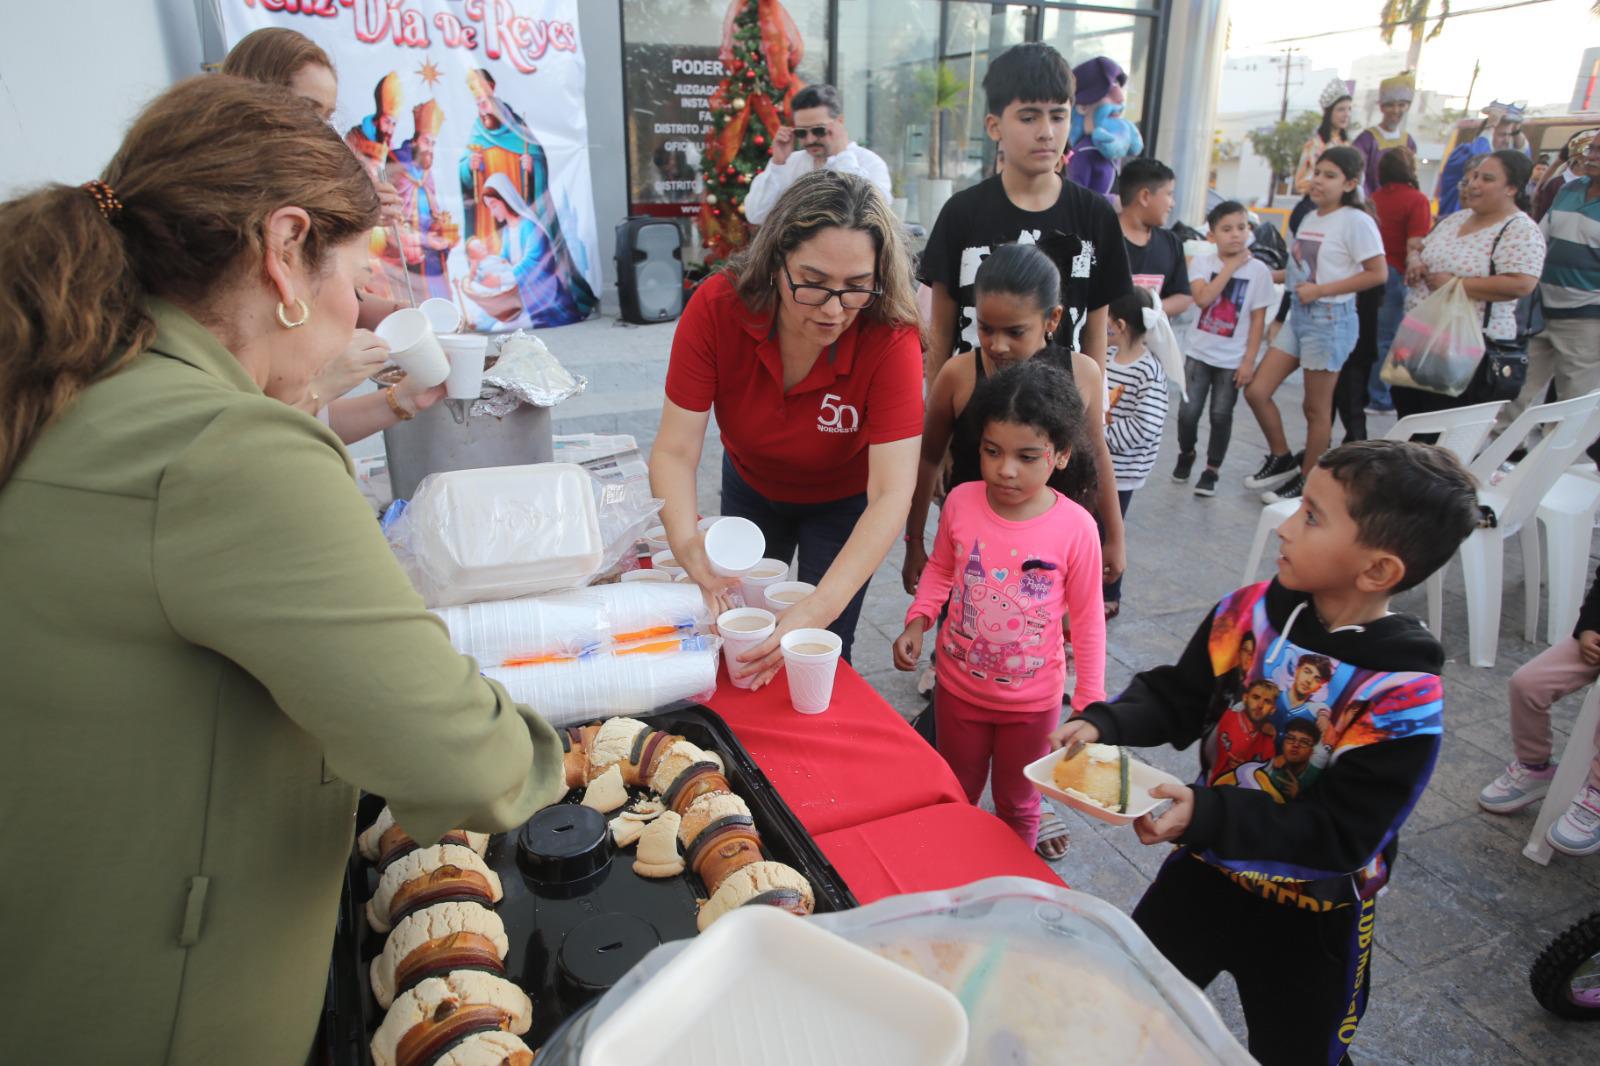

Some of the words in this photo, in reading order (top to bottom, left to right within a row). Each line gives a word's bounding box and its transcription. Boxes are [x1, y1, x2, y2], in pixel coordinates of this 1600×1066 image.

[465, 0, 577, 74] Reyes
[672, 59, 724, 76] PODER
[681, 97, 710, 108] INSTA
[699, 111, 715, 121] FA
[654, 123, 699, 134] DISTRITO
